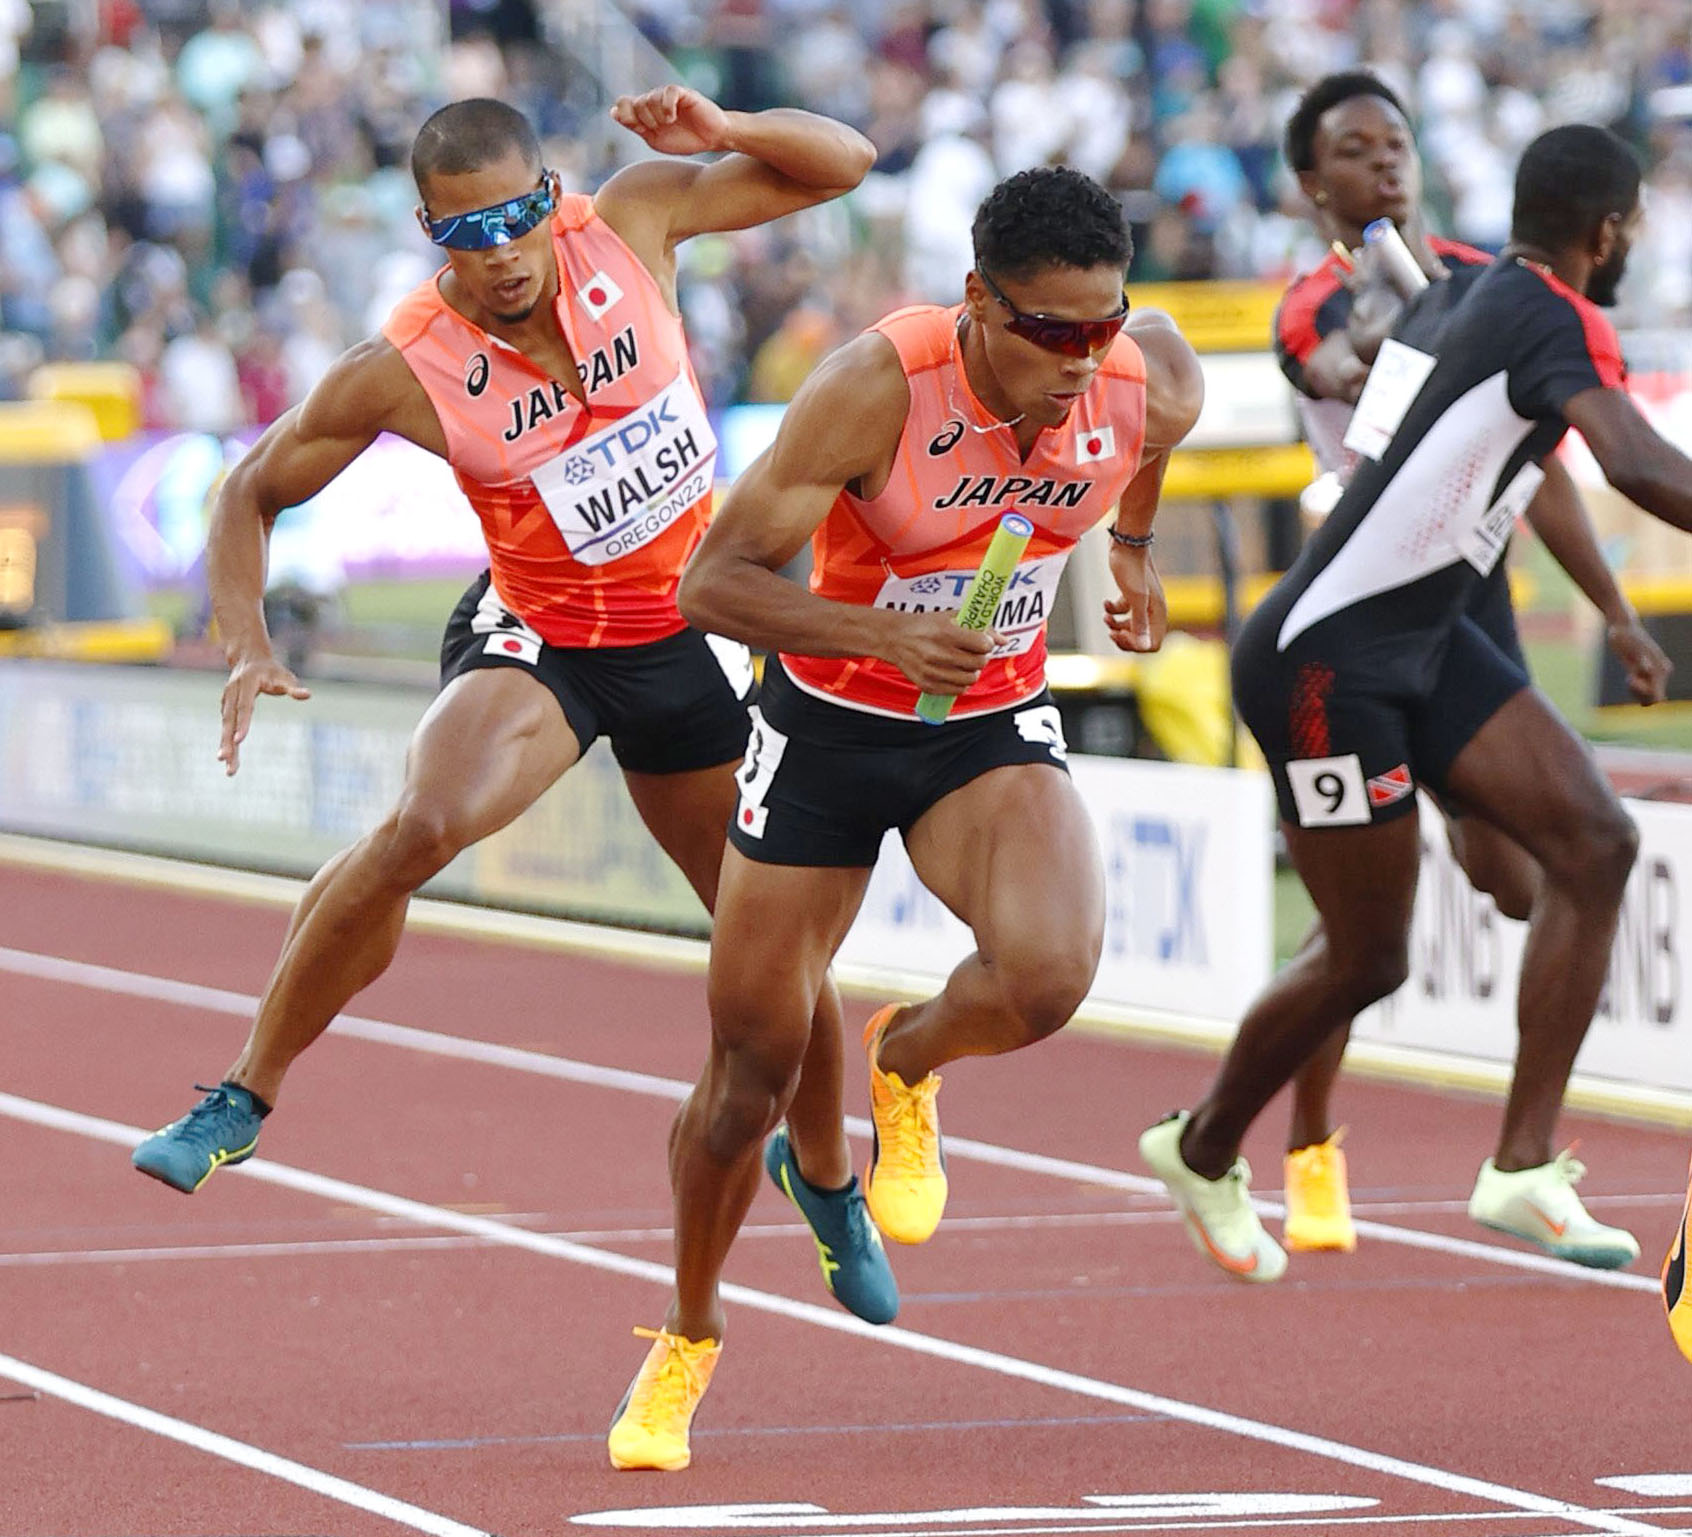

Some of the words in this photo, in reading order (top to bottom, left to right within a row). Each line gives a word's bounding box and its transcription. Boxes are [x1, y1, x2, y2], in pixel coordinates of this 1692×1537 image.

[586, 395, 680, 468] TDK
[574, 427, 699, 533] WALSH
[934, 476, 1093, 509] JAPAN
[605, 475, 707, 557] OREGON22
[944, 564, 1044, 598] TK
[1314, 772, 1344, 814] 9
